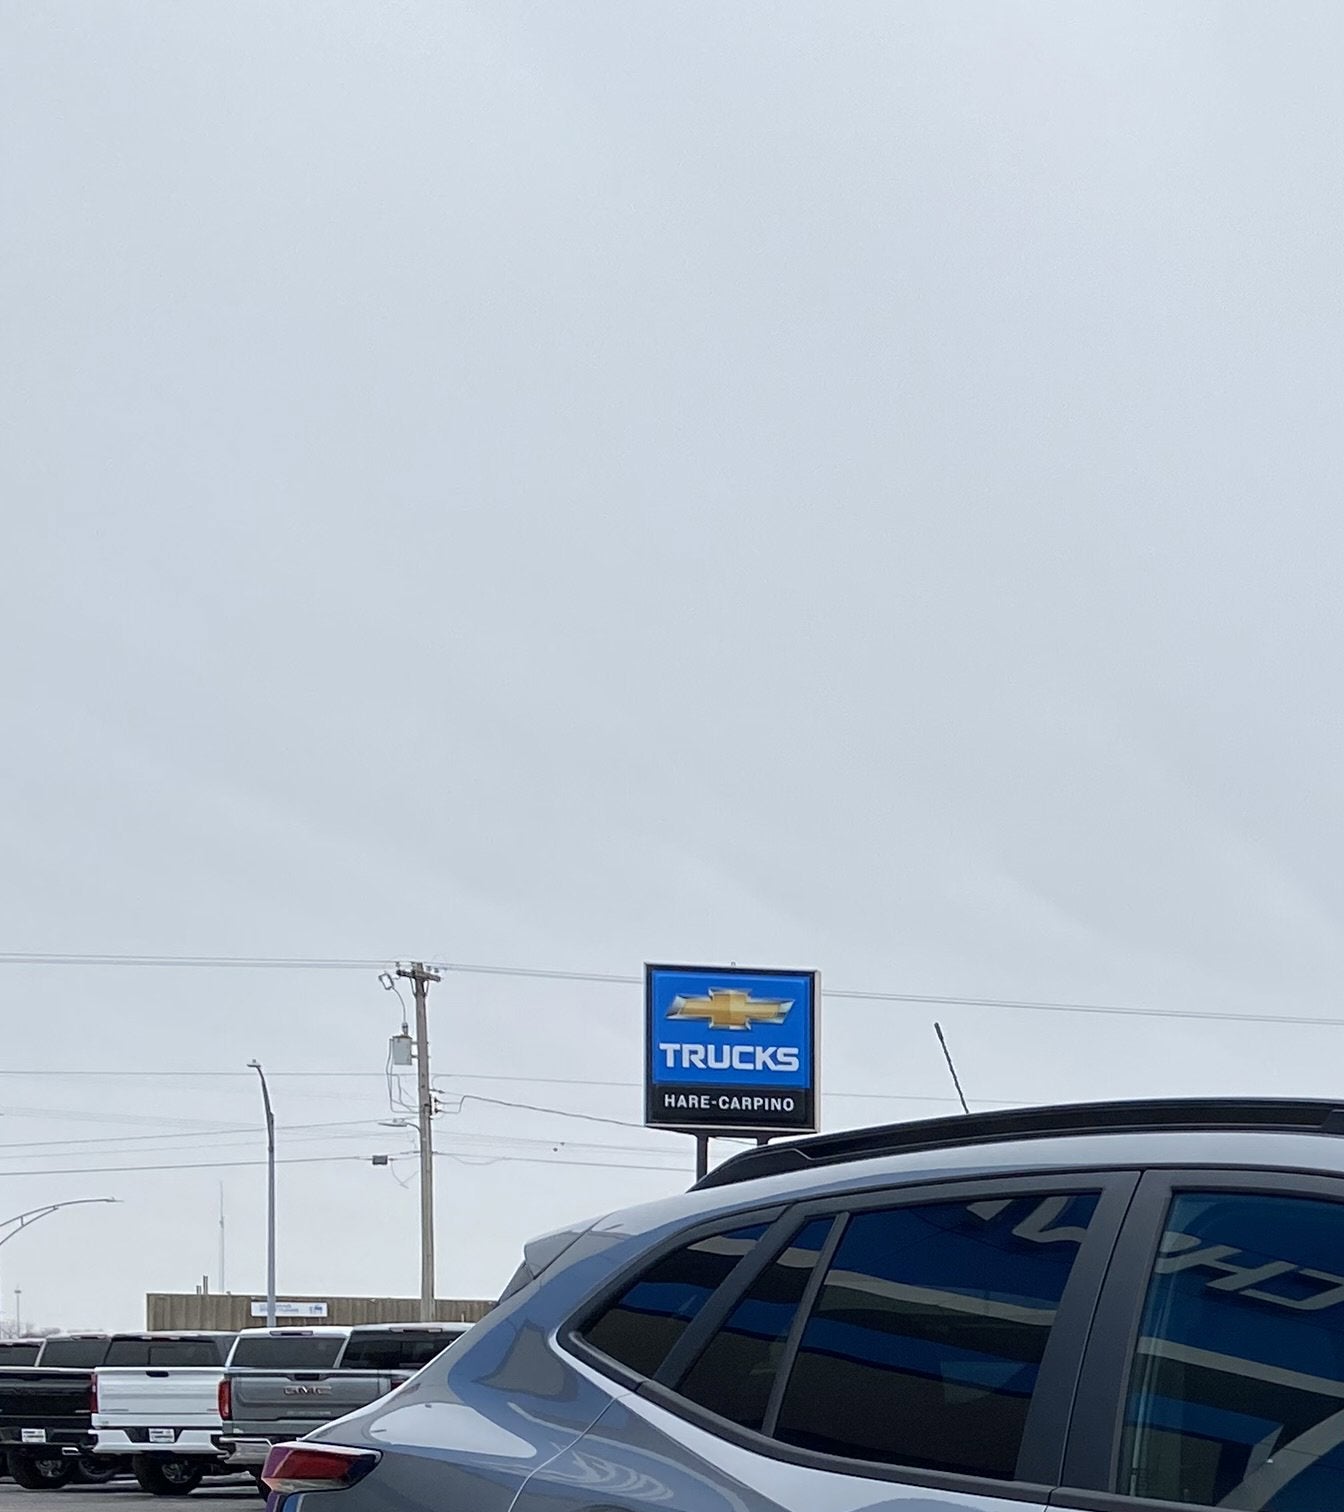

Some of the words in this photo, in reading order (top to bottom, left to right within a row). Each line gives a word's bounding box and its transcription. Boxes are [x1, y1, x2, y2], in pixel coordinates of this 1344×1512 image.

[659, 1042, 800, 1072] TRUCKS
[664, 1094, 795, 1112] HARE-CARPINO
[283, 1385, 332, 1396] GMC
